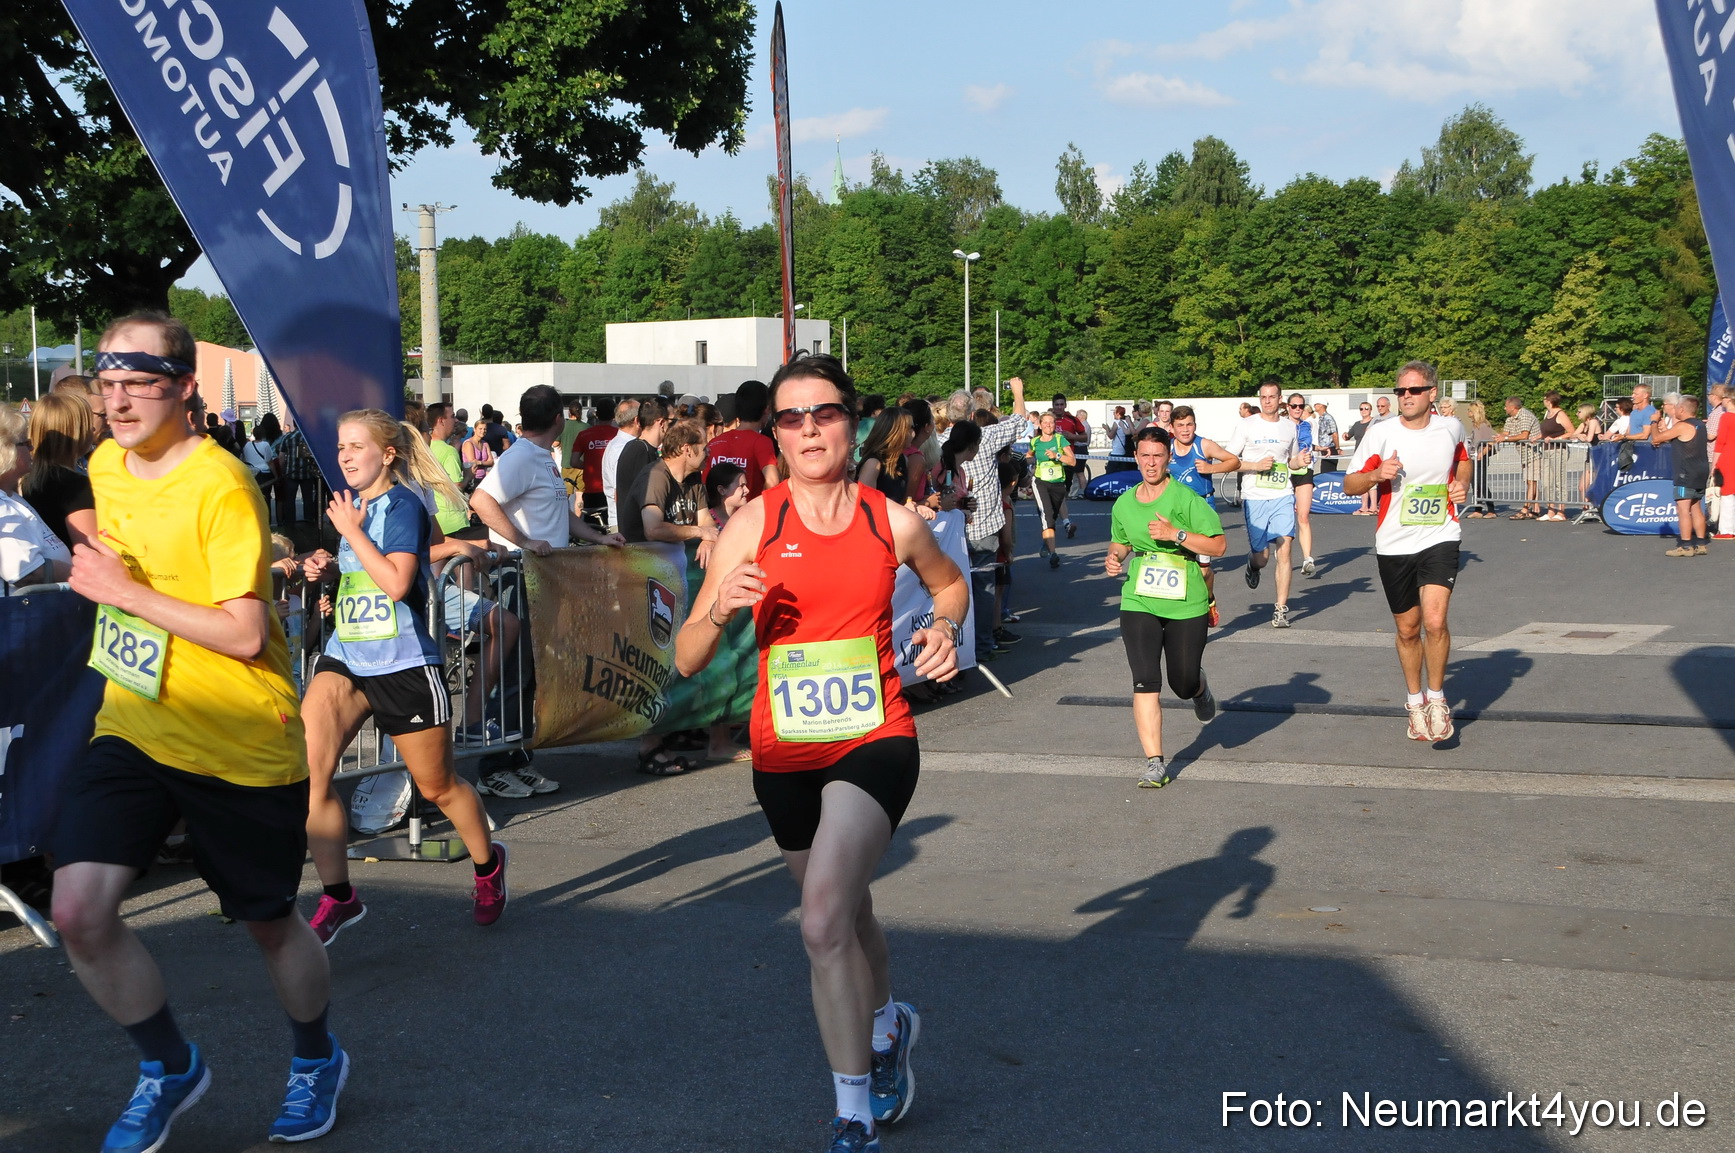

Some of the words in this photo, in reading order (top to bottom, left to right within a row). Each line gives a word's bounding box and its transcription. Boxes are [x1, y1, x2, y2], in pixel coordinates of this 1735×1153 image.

[1408, 498, 1441, 515] 305
[1144, 567, 1179, 588] 576
[337, 594, 391, 624] 1225
[98, 614, 160, 678] 1282
[773, 672, 877, 717] 1305
[808, 724, 860, 734] Neumarkt-Parsberg
[823, 716, 852, 726] Behrends
